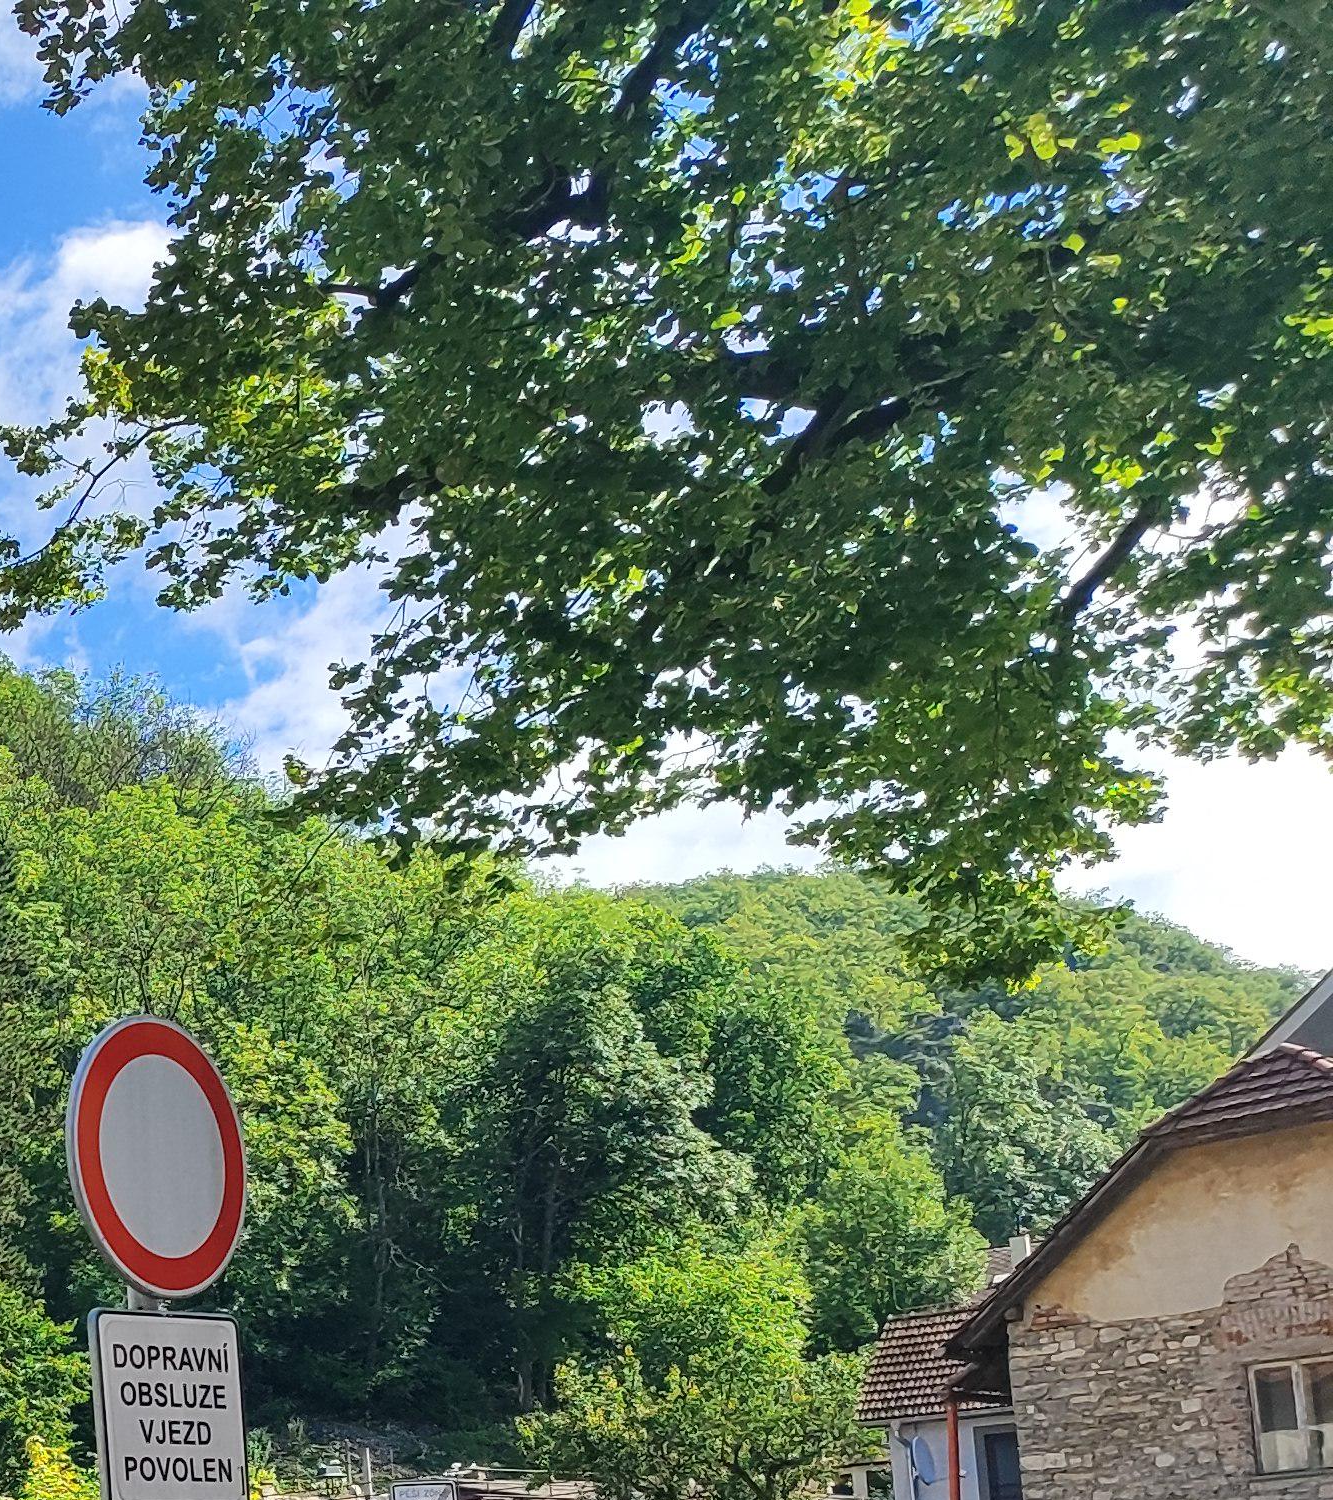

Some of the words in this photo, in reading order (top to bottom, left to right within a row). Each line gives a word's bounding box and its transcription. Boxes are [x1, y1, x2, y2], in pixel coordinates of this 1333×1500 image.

[112, 1342, 229, 1373] DOPRAVNÍ
[119, 1381, 228, 1410] OBSLUZE
[138, 1418, 212, 1446] VJEZD
[124, 1456, 233, 1483] POVOLEN
